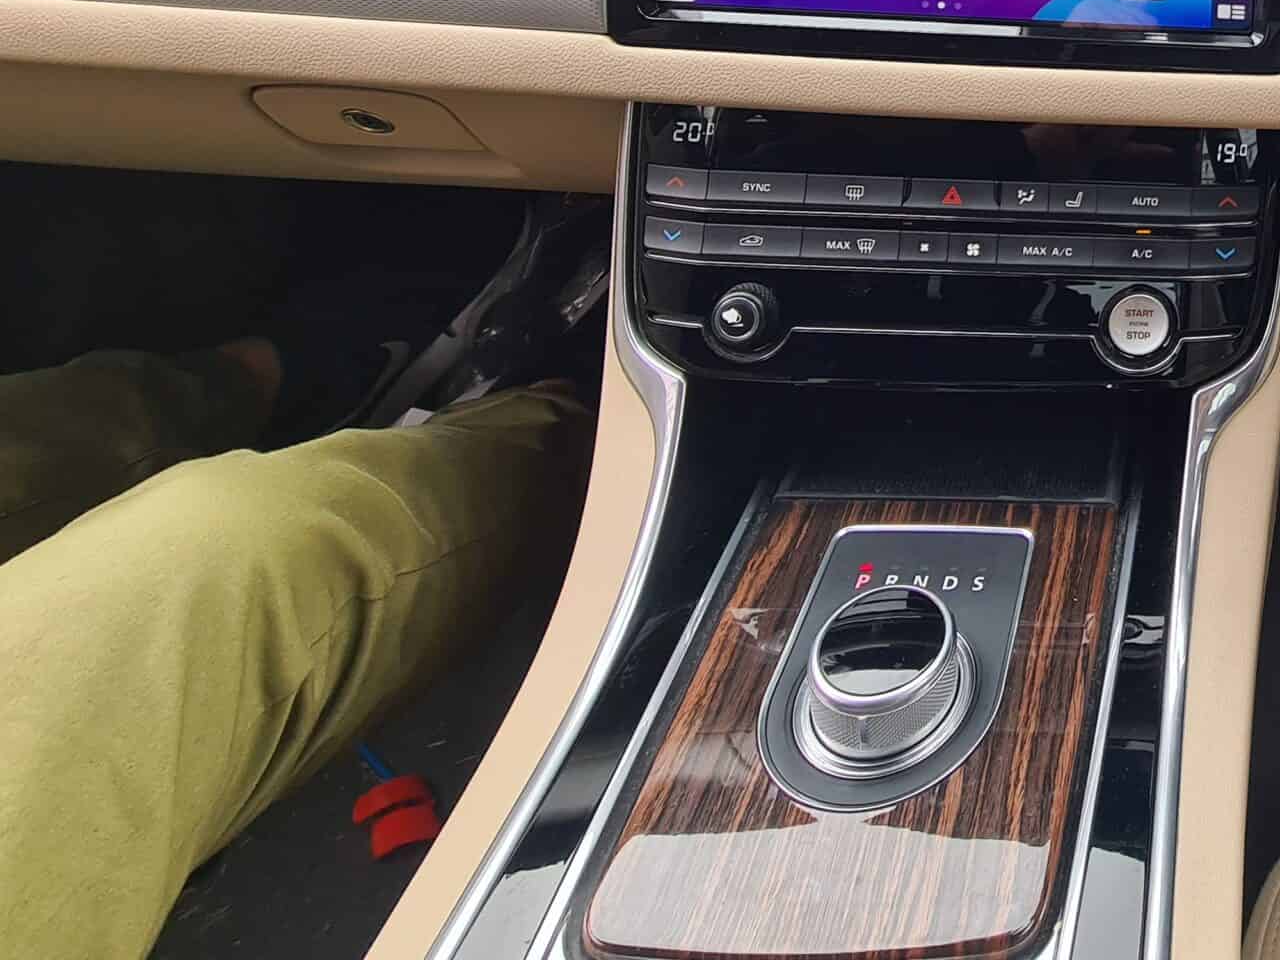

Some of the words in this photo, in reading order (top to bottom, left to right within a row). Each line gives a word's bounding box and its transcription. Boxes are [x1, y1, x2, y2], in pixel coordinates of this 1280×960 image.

[742, 182, 771, 193] SYNC
[1131, 196, 1159, 207] AUTO
[826, 240, 851, 250] MAX
[1022, 246, 1047, 257] MAX
[1051, 247, 1073, 258] A/C
[1131, 249, 1153, 259] A/C
[1125, 309, 1154, 318] START
[1126, 330, 1151, 340] STOP
[855, 575, 872, 590] P
[885, 574, 899, 586] R
[912, 575, 930, 589] N
[942, 576, 959, 591] D
[971, 575, 985, 592] S
